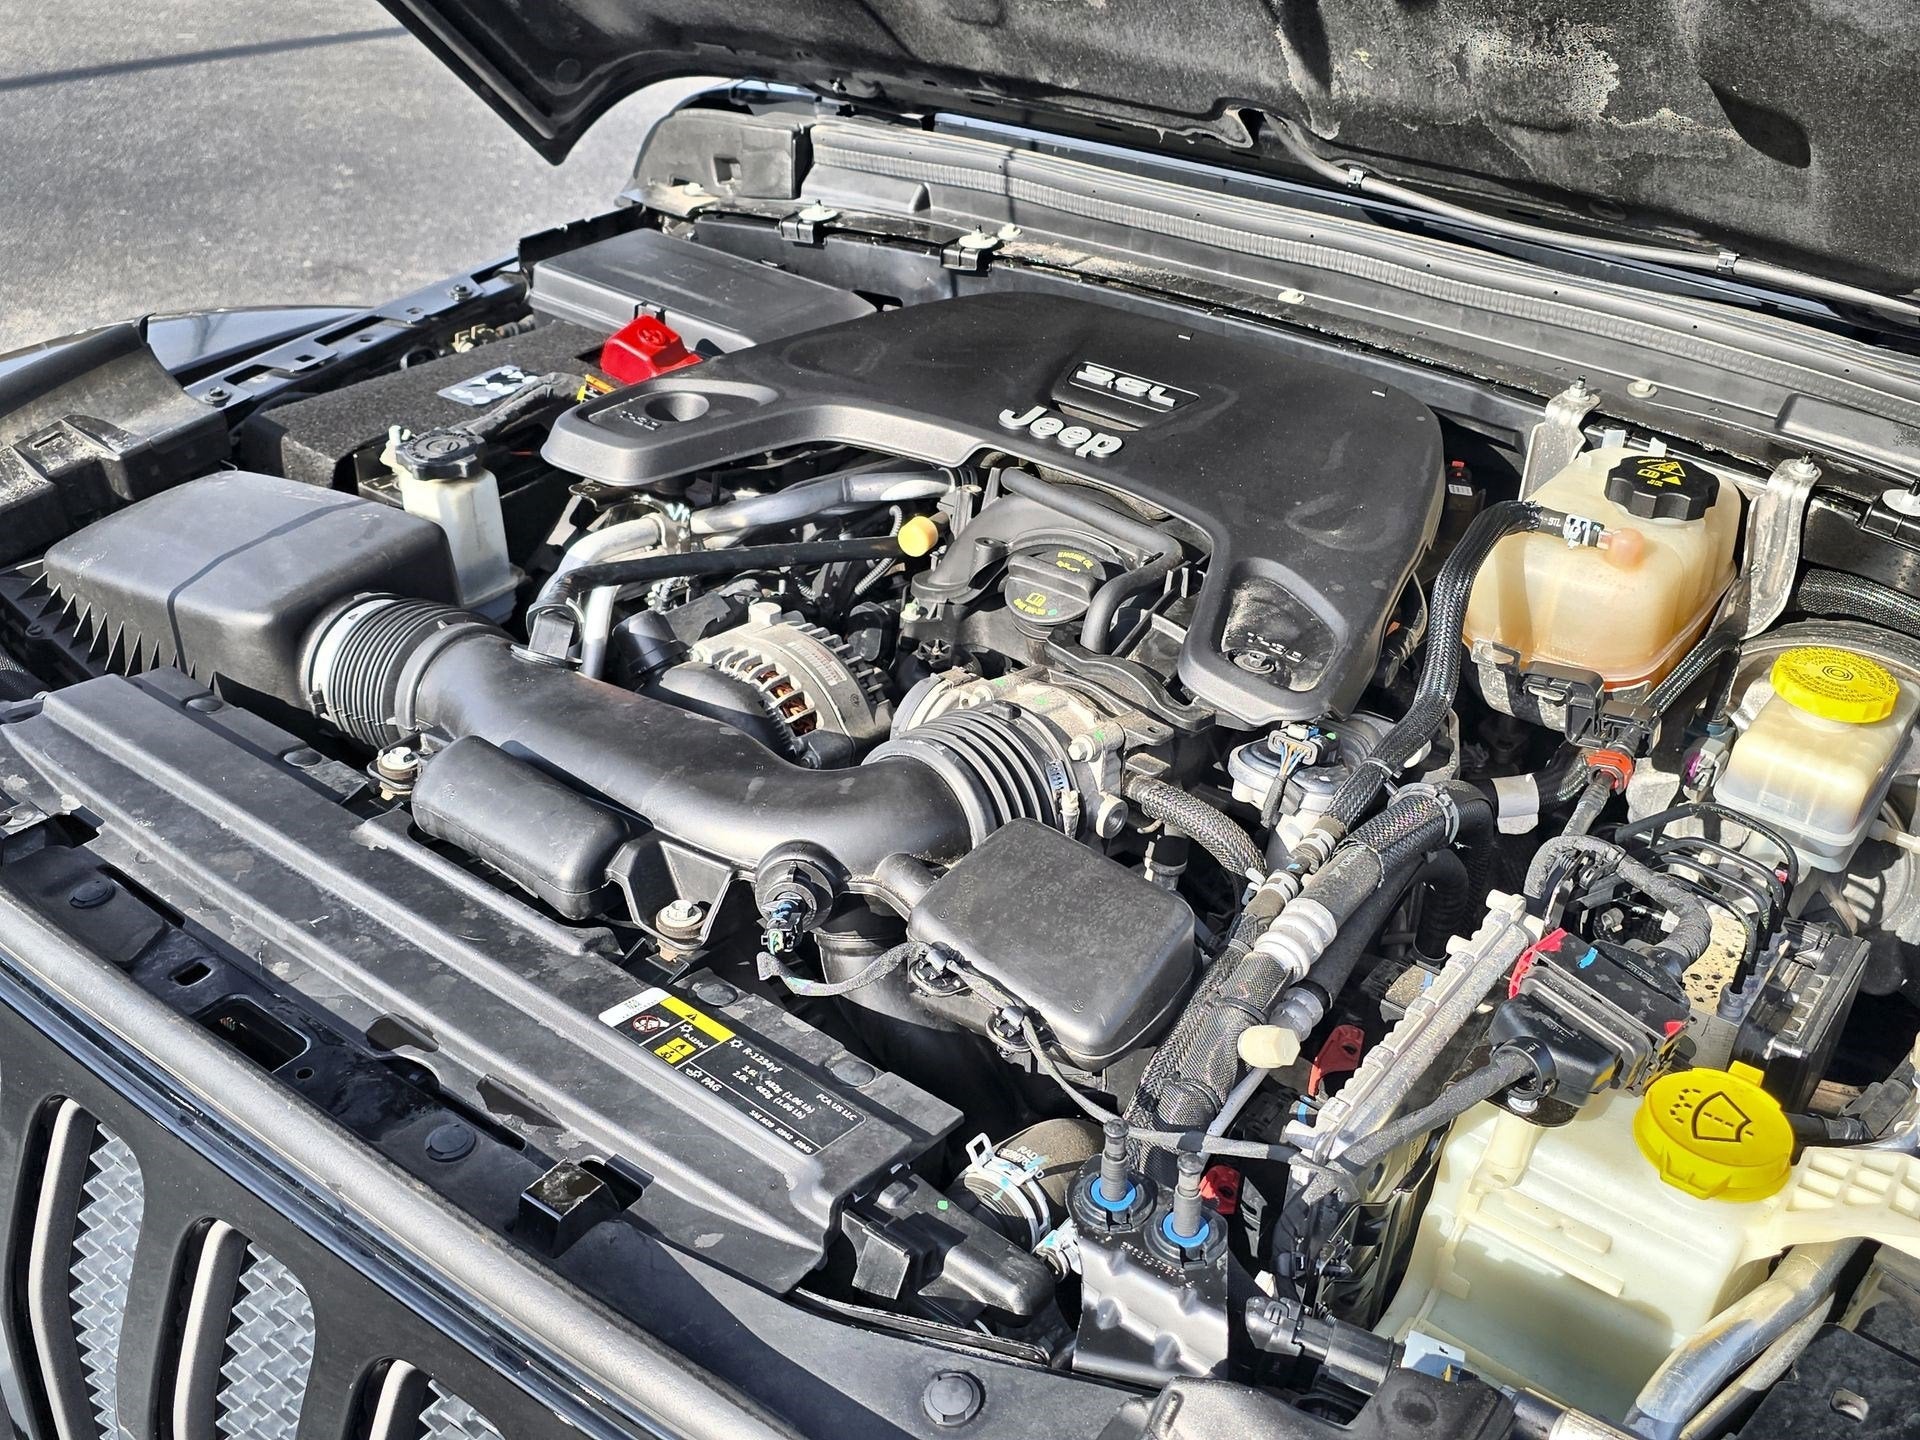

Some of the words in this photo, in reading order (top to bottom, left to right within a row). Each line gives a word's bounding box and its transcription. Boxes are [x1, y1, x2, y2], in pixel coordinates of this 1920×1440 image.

[1076, 365, 1176, 407] 3.6L
[998, 405, 1124, 458] Jeep
[742, 1047, 783, 1073] R-1234yf
[701, 1077, 722, 1092] PAG
[732, 1070, 749, 1083] 2.0L
[816, 1093, 832, 1106] FCA
[831, 1103, 843, 1113] US
[841, 1110, 858, 1121] LLC
